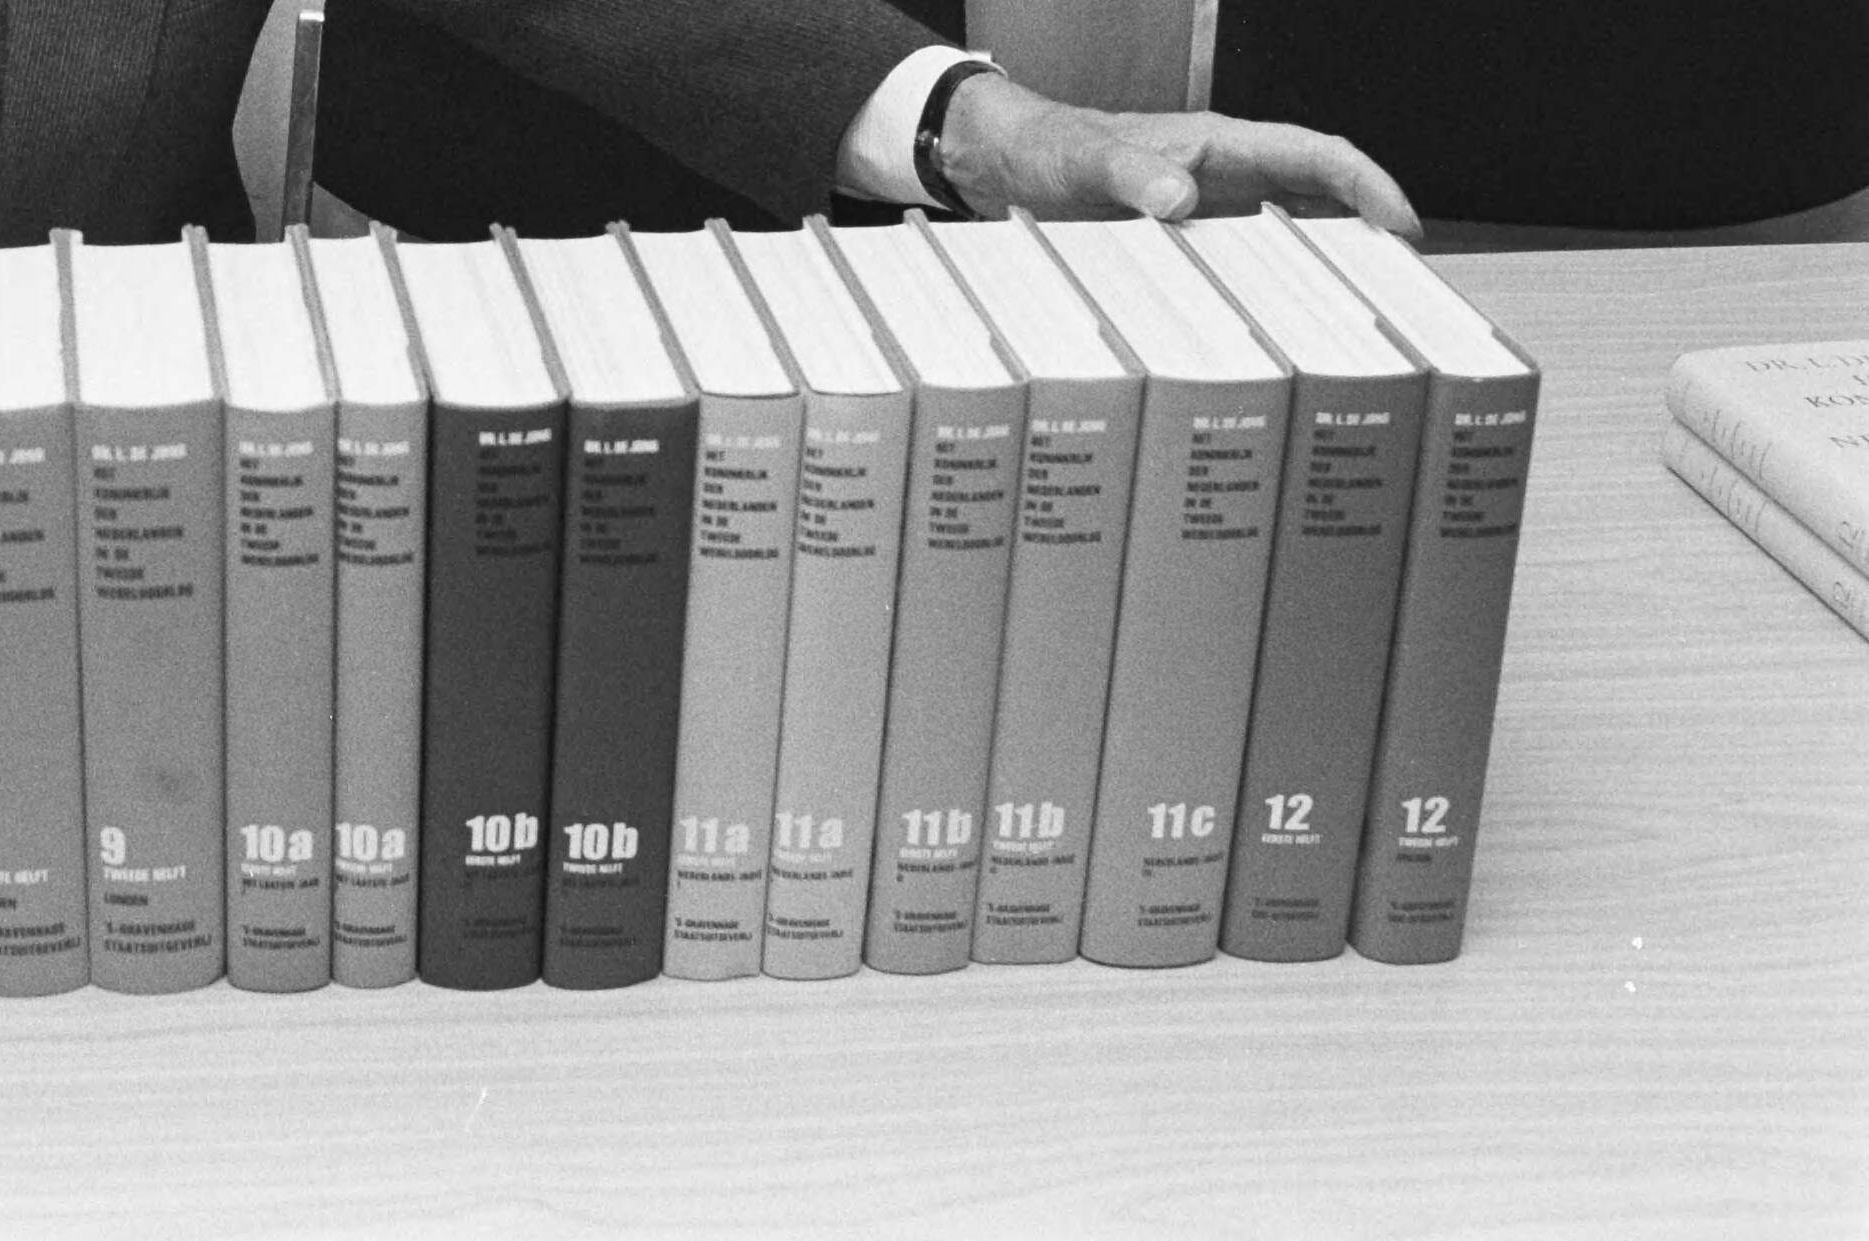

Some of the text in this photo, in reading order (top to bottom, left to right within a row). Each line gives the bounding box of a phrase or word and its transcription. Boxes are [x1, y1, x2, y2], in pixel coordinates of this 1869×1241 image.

[774, 811, 844, 849] 11a
[901, 808, 972, 846] 11b
[994, 801, 1065, 838] 11b
[1265, 793, 1315, 831] 12
[1401, 796, 1450, 834] 12
[100, 826, 126, 865] 9
[240, 824, 314, 862] 10a
[336, 822, 406, 861] 10a
[465, 812, 539, 852] 10b
[563, 822, 639, 860] 10b
[679, 815, 750, 853] 11a
